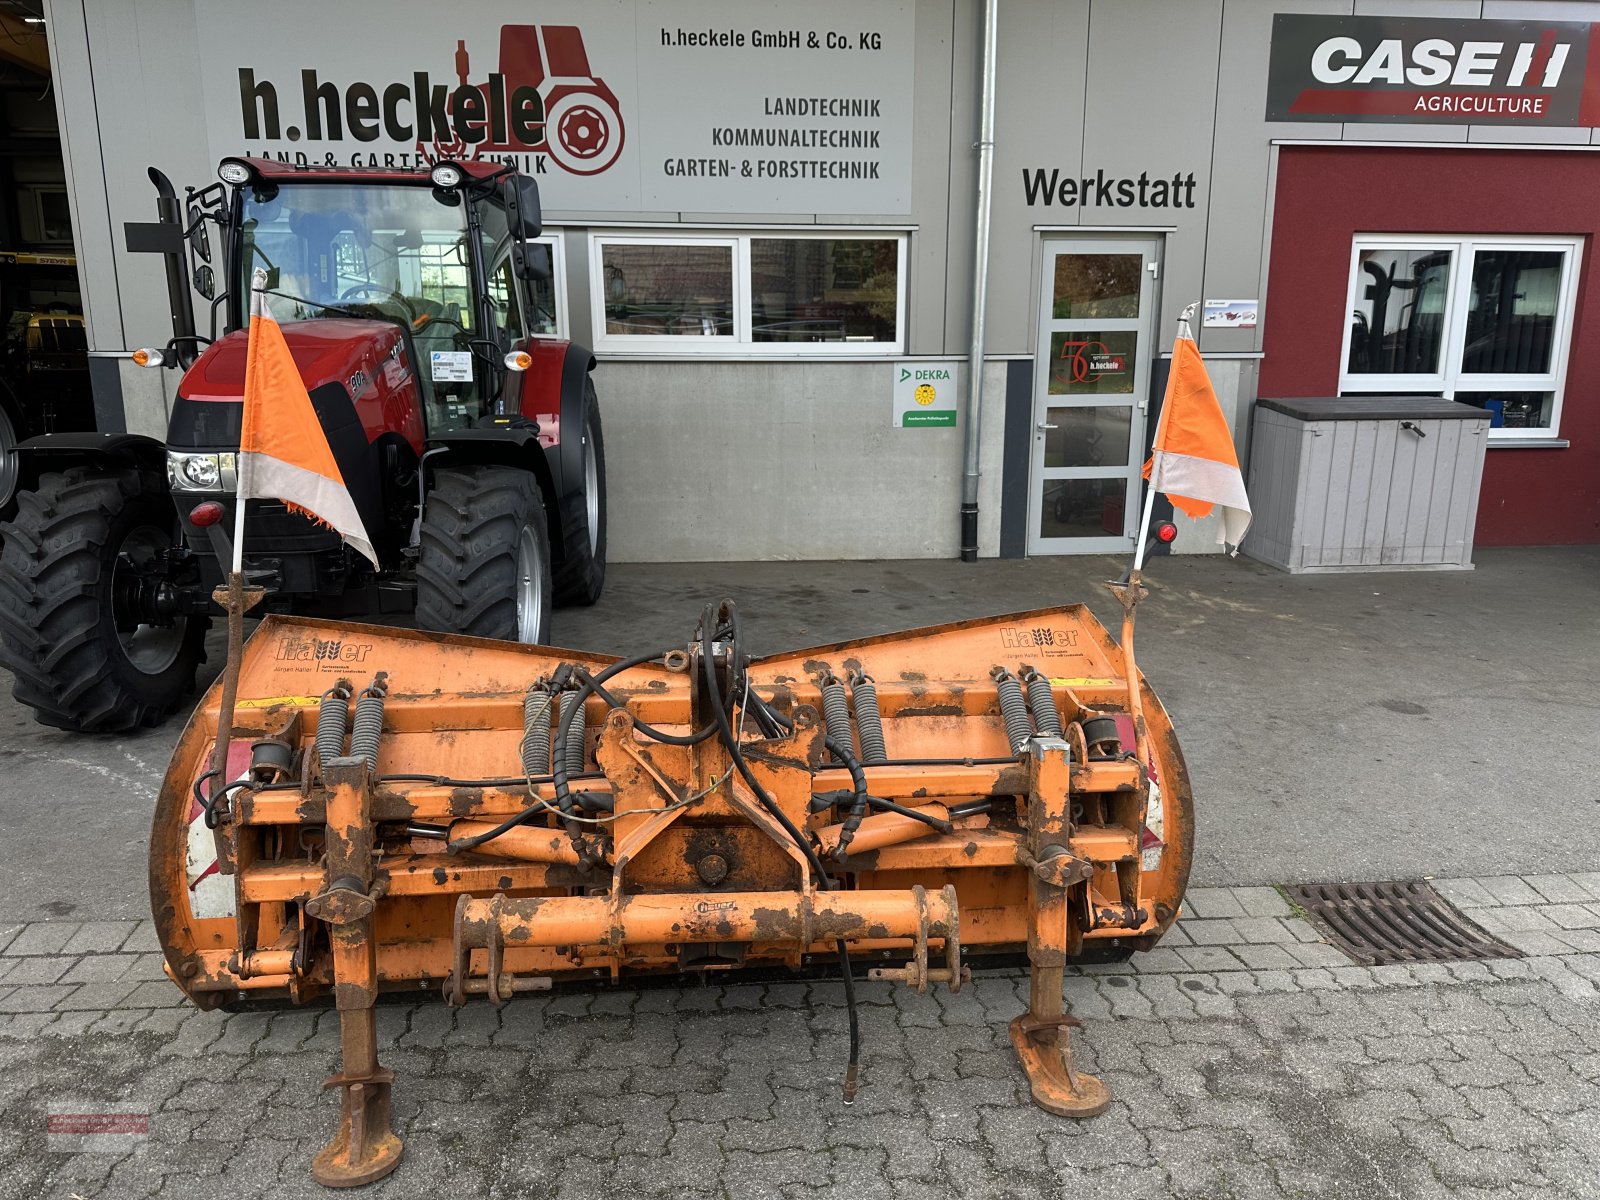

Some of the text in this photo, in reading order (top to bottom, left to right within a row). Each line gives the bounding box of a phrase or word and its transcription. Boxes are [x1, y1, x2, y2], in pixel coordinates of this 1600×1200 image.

[661, 28, 881, 50] h.heckele GmbH & Co. KG
[1311, 36, 1504, 85] CASE
[238, 67, 546, 145] h.heckele
[764, 98, 881, 117] LANDTECHNIK
[1414, 96, 1543, 113] AGRICULTURE
[712, 128, 880, 148] KOMMUNALTECHNIK
[664, 159, 880, 179] GARTEN- & FORSTTECHNIK
[1022, 168, 1196, 208] Werkstatt
[915, 369, 950, 380] DEKRA
